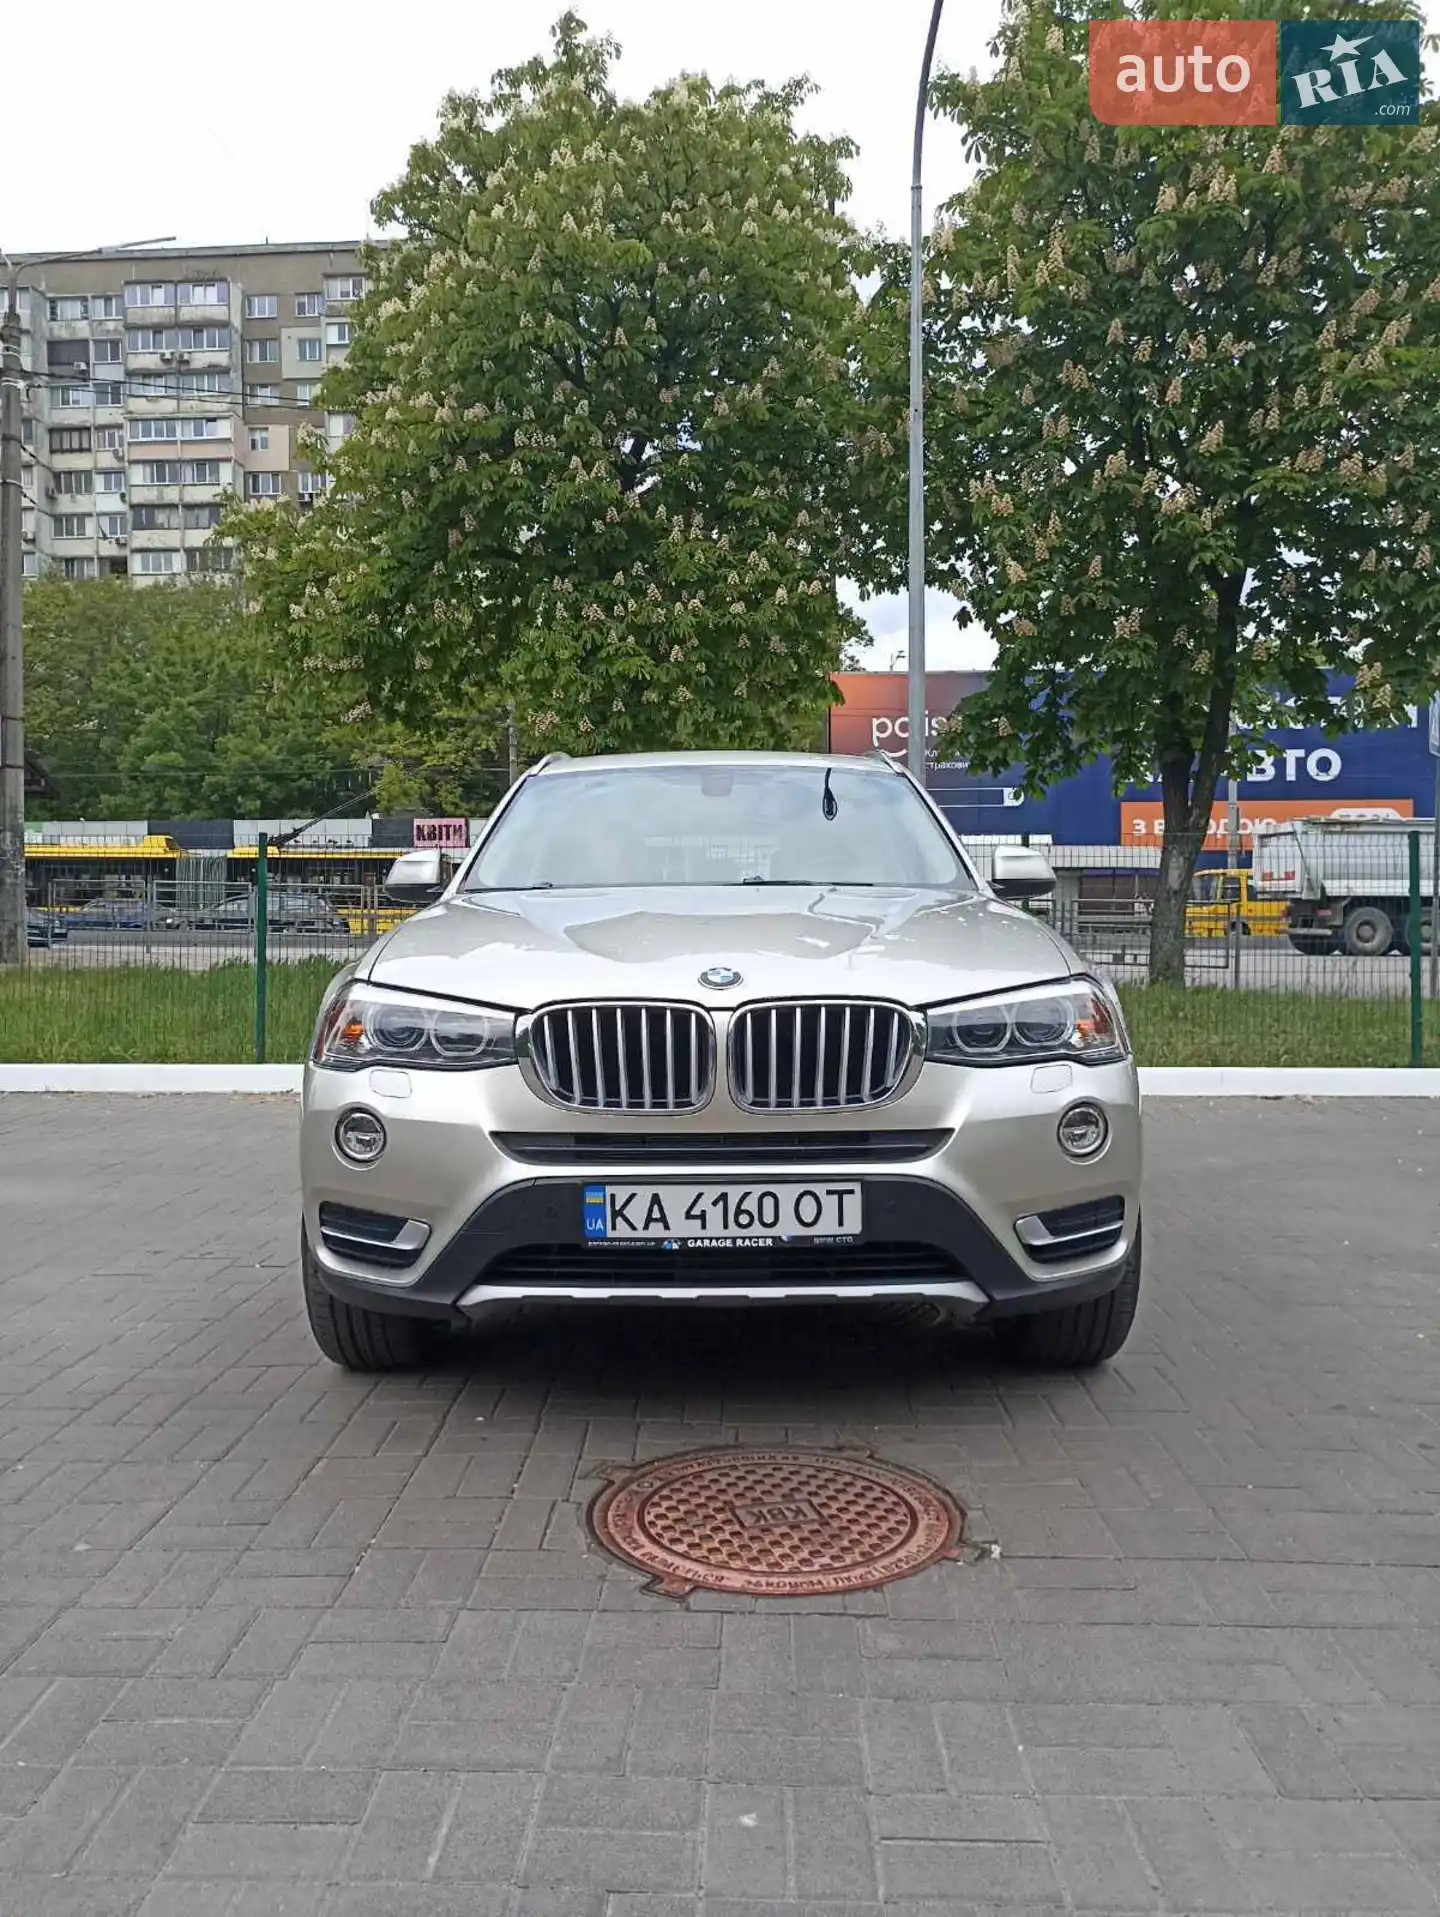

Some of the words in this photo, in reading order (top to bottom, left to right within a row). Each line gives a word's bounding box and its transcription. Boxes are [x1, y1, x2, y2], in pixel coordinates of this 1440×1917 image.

[416, 824, 463, 841] КВІТИ
[684, 1191, 780, 1230] 4160
[586, 1220, 604, 1231] UA
[687, 1238, 733, 1249] GARAGE
[736, 1237, 773, 1248] RACER
